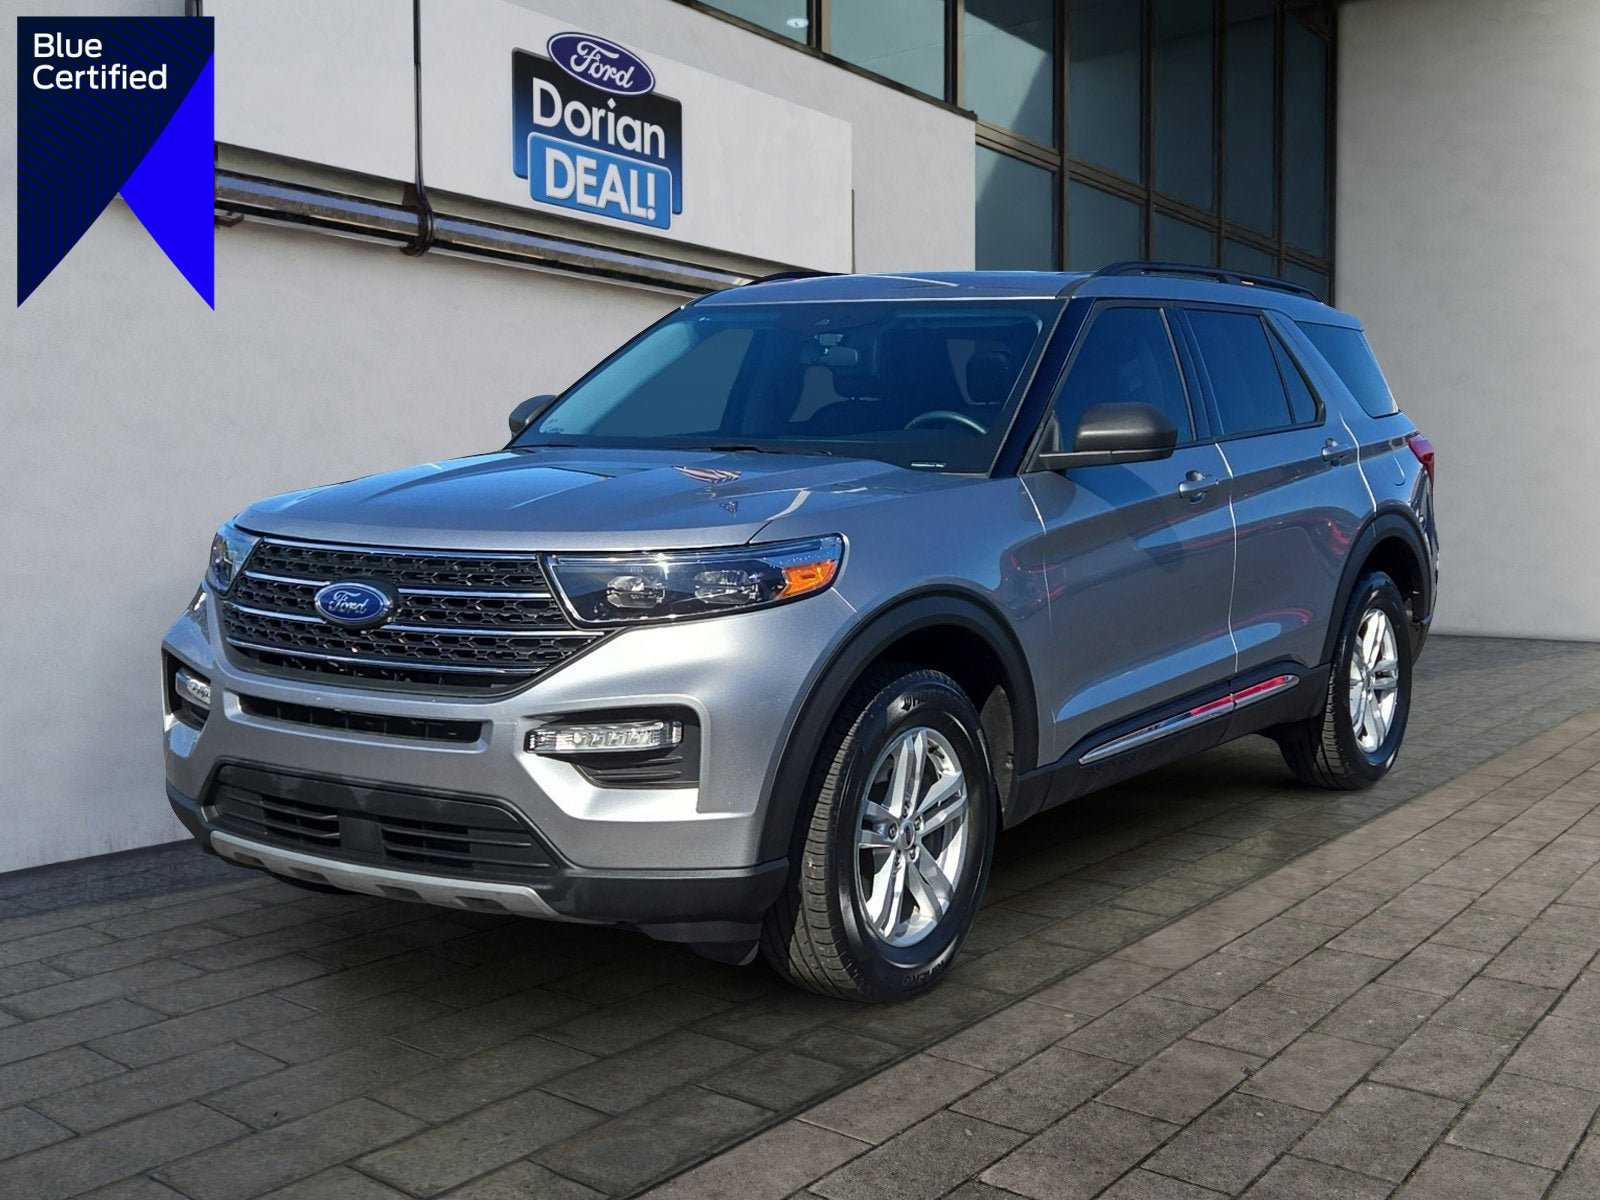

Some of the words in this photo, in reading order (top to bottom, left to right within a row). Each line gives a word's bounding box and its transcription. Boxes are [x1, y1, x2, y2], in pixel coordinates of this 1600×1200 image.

[570, 41, 635, 88] Ford
[532, 77, 666, 159] Dorian
[545, 147, 657, 221] DEAL!
[328, 590, 369, 614] Ford
